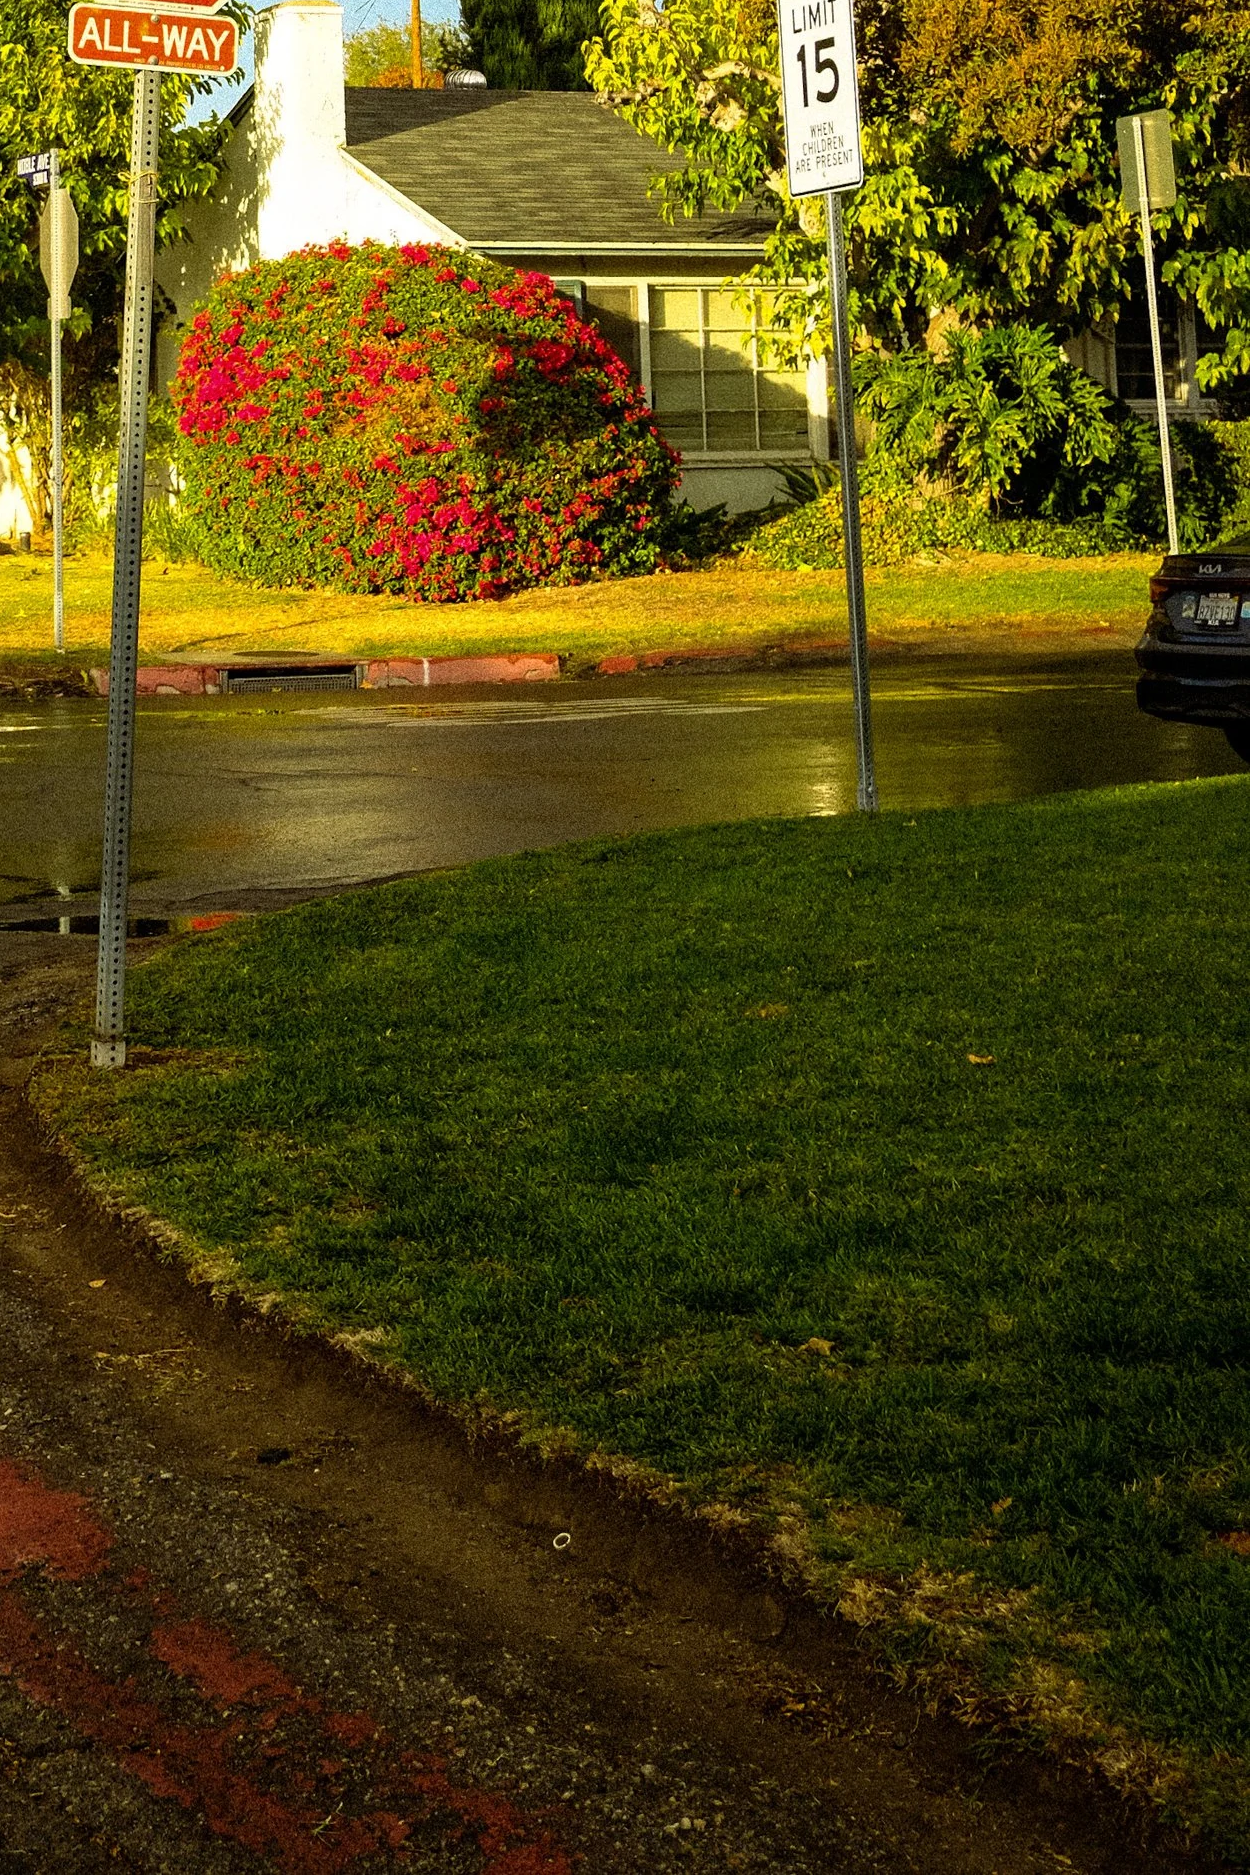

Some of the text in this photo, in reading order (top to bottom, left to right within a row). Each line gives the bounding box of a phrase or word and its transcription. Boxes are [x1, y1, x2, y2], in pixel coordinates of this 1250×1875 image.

[78, 17, 229, 61] ALL-WAY
[796, 36, 840, 108] 15
[810, 120, 834, 139] WHEN
[802, 134, 844, 156] CHILDREN
[795, 148, 853, 174] ARE PRESENT
